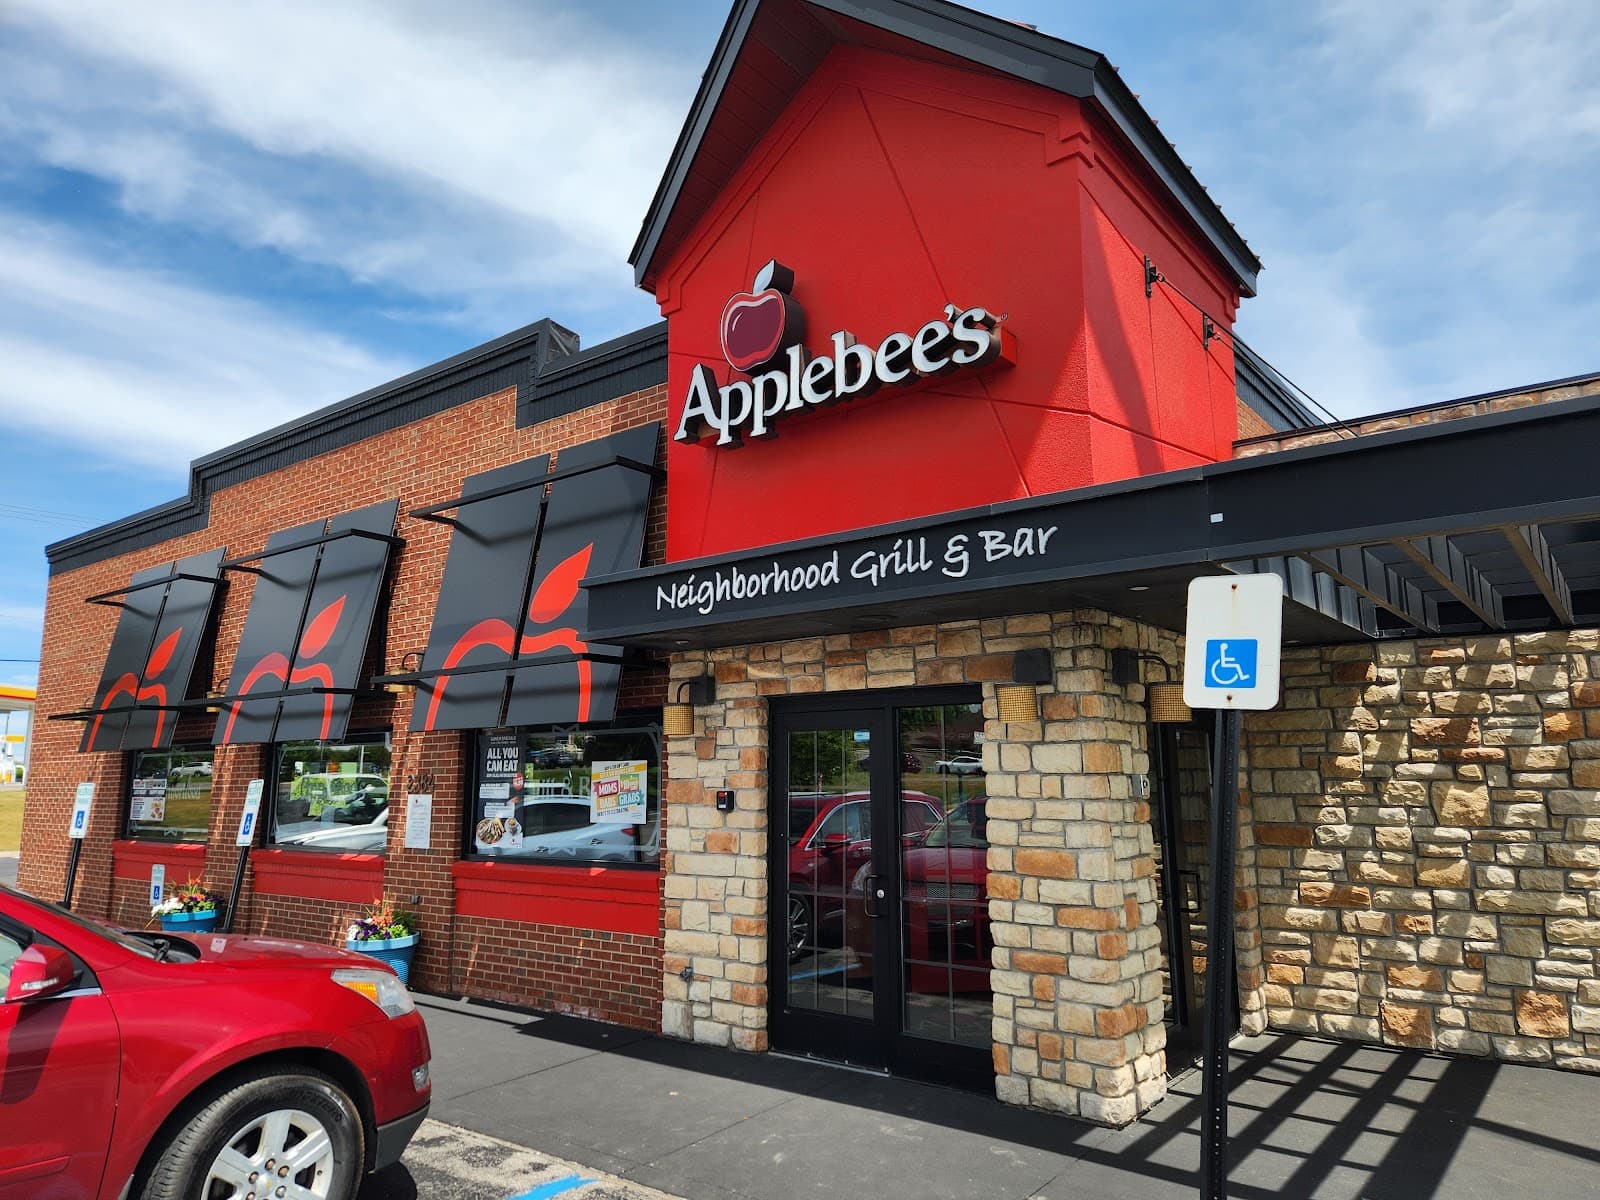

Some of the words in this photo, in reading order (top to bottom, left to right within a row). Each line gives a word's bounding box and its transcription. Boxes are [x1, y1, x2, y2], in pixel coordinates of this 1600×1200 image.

[673, 302, 995, 446] Applebee's
[656, 550, 840, 615] Neighborhood
[850, 537, 933, 586] Grill
[942, 534, 970, 578] &
[978, 525, 1058, 563] Bar
[502, 747, 519, 760] YOU
[486, 760, 502, 772] CAN
[503, 760, 519, 772] EAT
[598, 782, 618, 796] MOMS
[619, 791, 640, 806] GRADS
